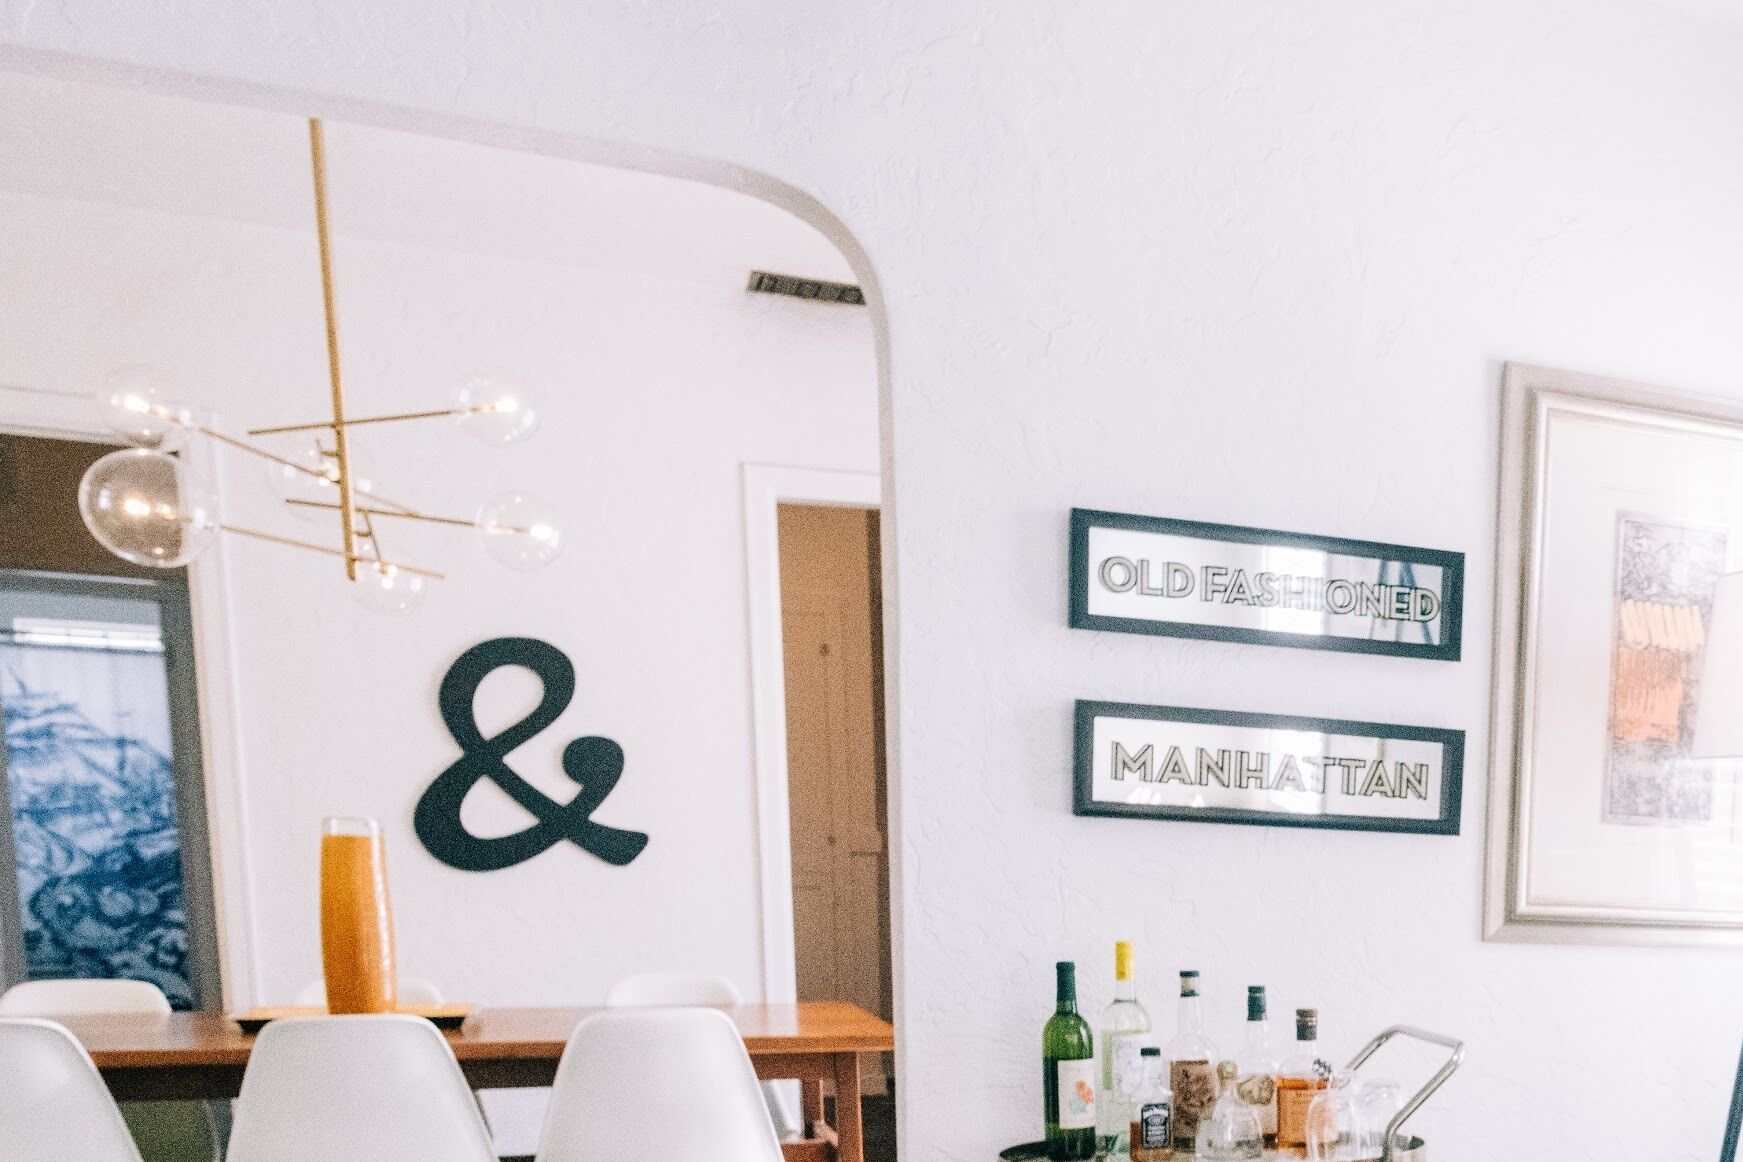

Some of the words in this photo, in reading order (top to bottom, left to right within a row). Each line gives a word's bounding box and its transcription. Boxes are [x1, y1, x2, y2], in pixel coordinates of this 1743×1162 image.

[1098, 556, 1194, 598] OLD
[1201, 565, 1441, 622] FASHIONED
[1111, 741, 1428, 800] MANHATTAN
